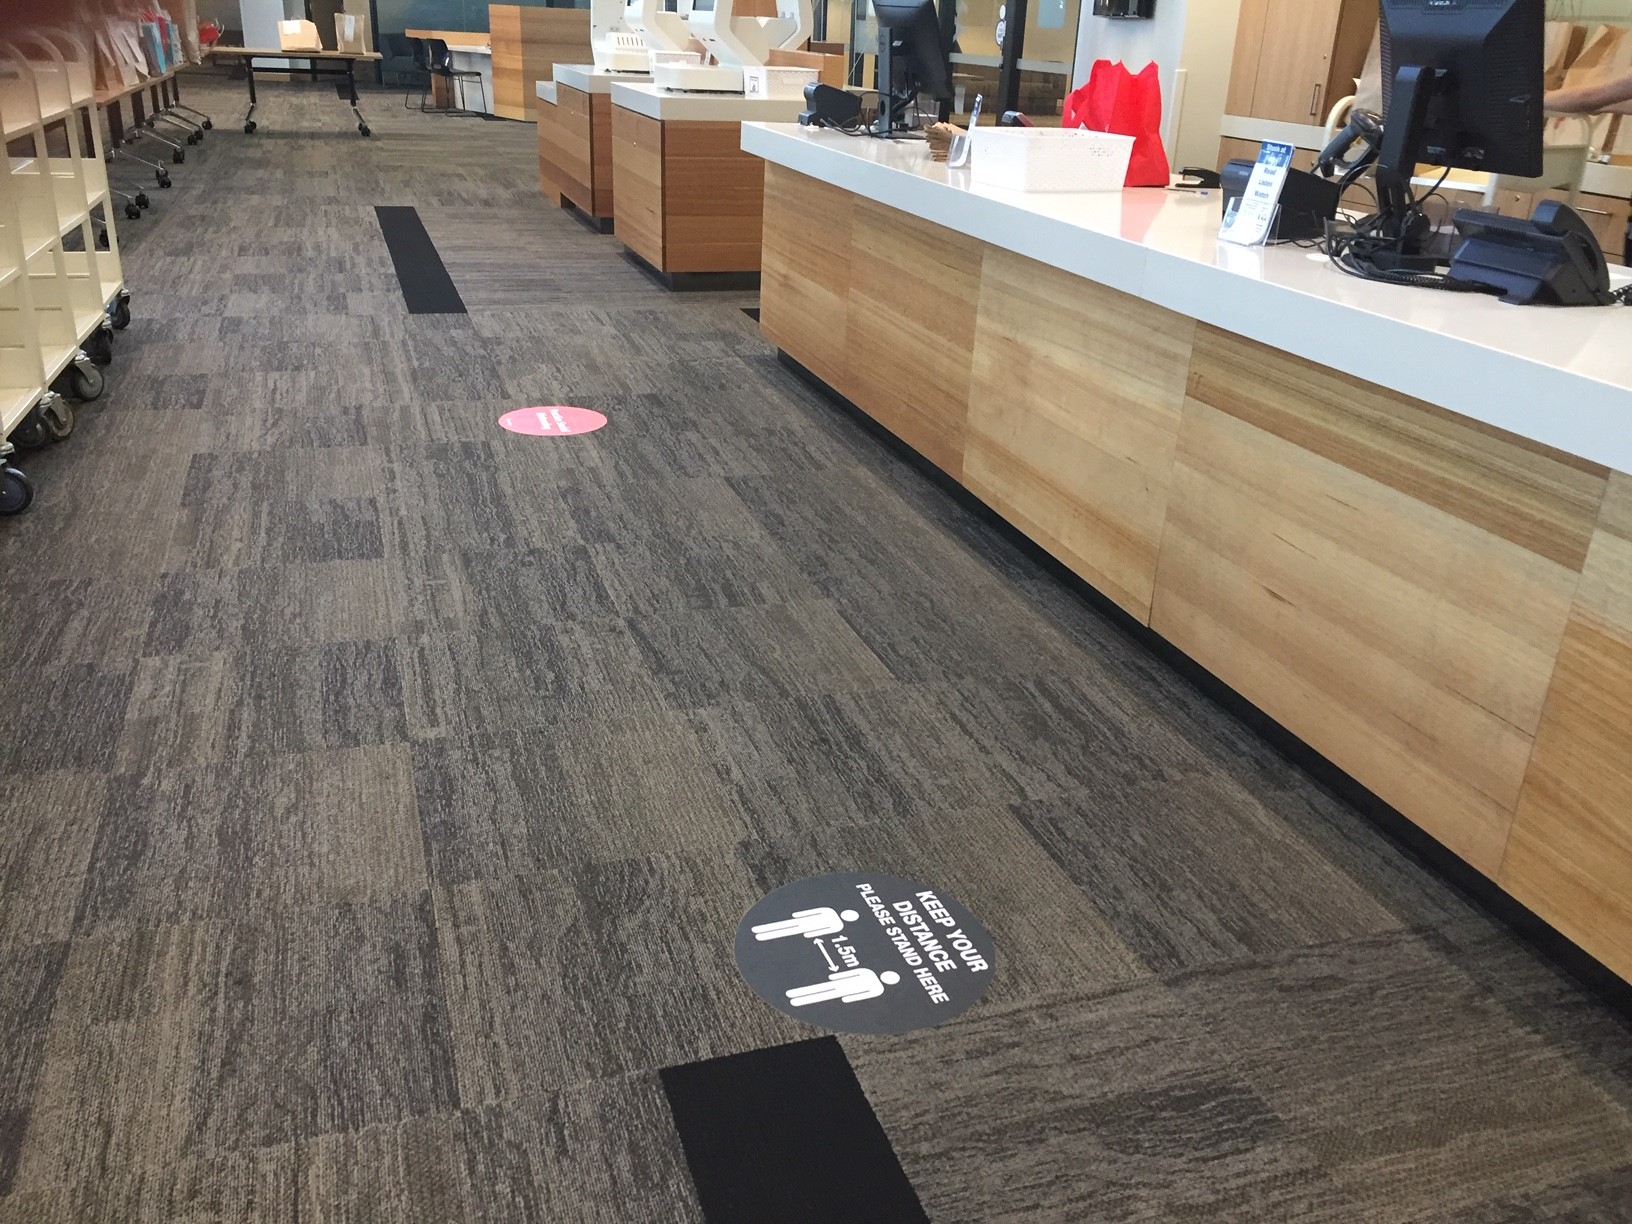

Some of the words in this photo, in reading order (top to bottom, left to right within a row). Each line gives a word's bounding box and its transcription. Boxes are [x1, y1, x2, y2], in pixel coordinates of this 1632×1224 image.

[831, 935, 860, 968] 1.5m
[855, 882, 896, 926] PLEASE
[886, 926, 922, 966] STAND
[913, 967, 950, 1004] HERE
[892, 900, 958, 972] DISTANCE
[915, 890, 956, 929] KEEP
[946, 928, 989, 973] YOUR
